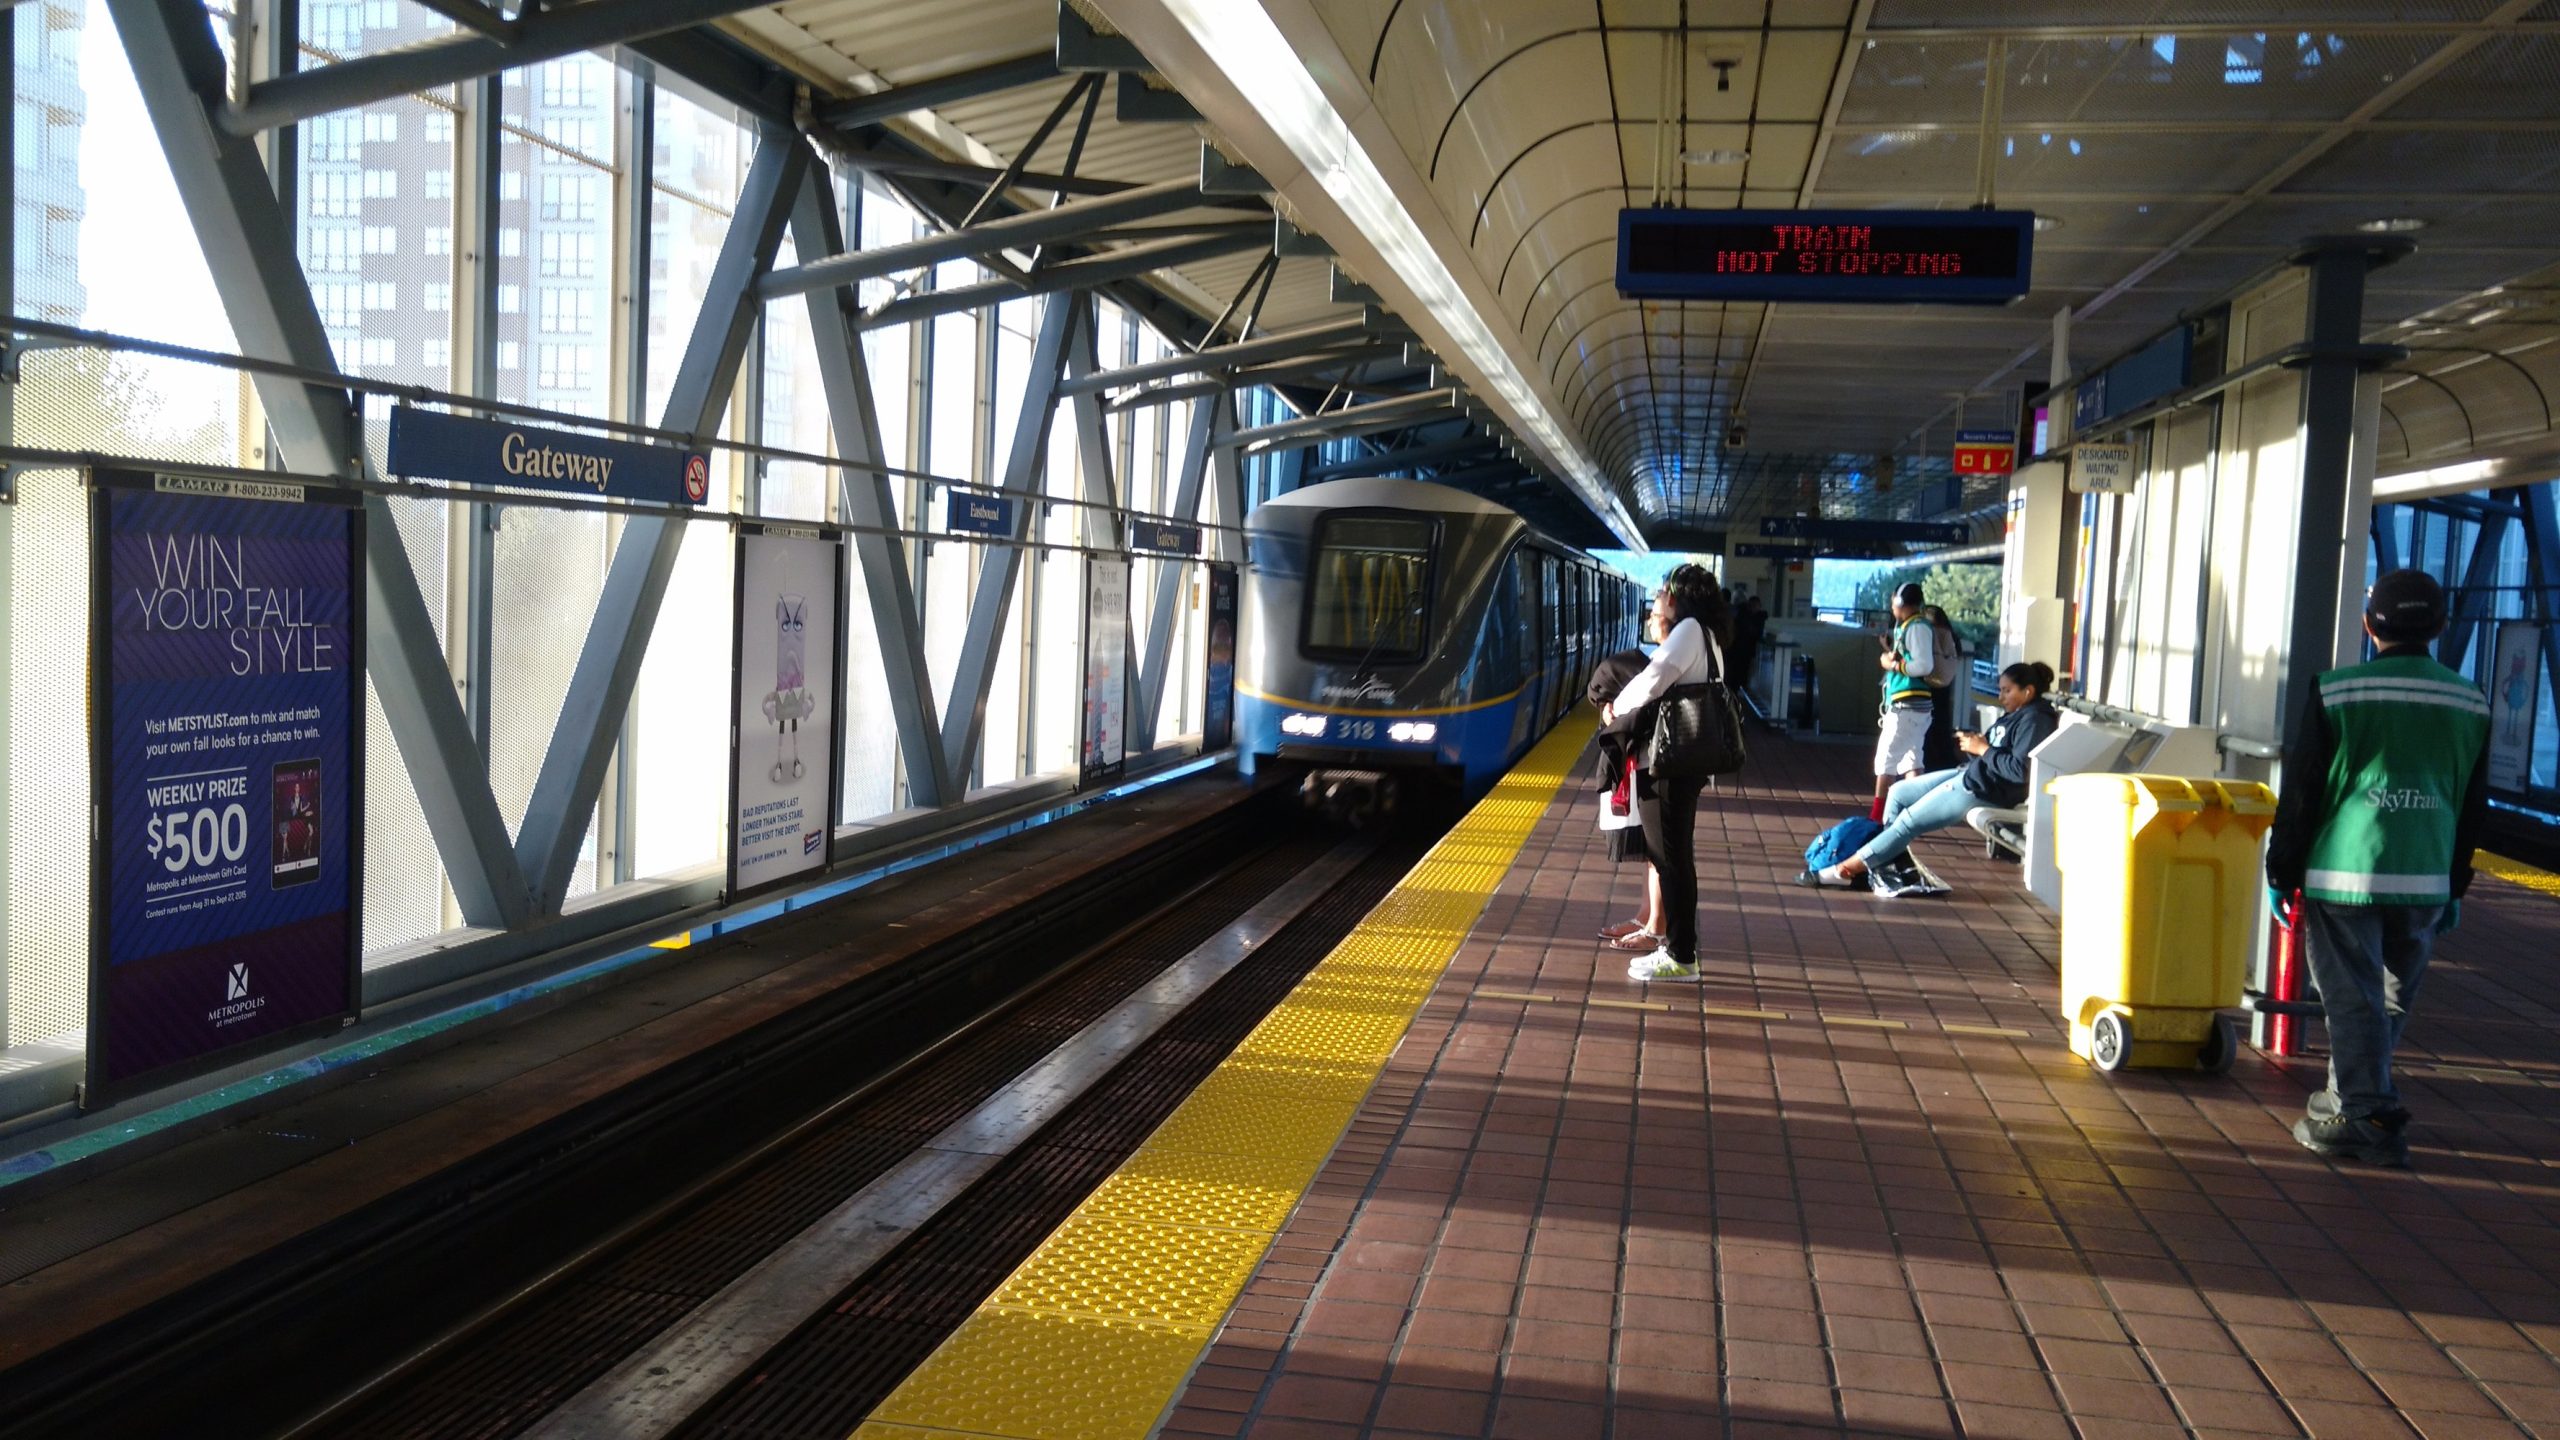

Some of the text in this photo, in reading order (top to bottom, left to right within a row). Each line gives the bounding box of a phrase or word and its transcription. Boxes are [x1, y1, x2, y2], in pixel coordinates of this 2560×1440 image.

[1773, 225, 1871, 251] TRAIN
[1717, 250, 1961, 276] NOT STOPPING
[501, 431, 613, 492] Gateway
[2077, 448, 2129, 460] DESIGNATED
[2086, 463, 2119, 476] WAITING
[165, 477, 302, 499] LAMAR 1-800-233-9942
[2089, 477, 2112, 489] AREA
[970, 502, 999, 521] Eastbound
[1156, 527, 1181, 551] Gateway
[147, 532, 243, 590] WIN
[135, 587, 313, 631] YOUR FALL
[230, 625, 332, 676] STYLE
[145, 705, 321, 735] Visit METSTYLIST.com to mix and match
[1336, 719, 1376, 741] 318
[146, 725, 320, 760] your own fall looks for a chance to win.
[147, 776, 247, 808] WEEKLY PRIZE
[742, 797, 799, 818] BAD REPUTATIONS LAST
[742, 819, 762, 833] LONGER
[763, 815, 777, 827] THAN
[777, 812, 788, 823] THIS
[147, 803, 248, 872] $500
[741, 834, 761, 847] BETTER
[761, 829, 774, 841] VISIT
[774, 826, 784, 837] THE
[146, 863, 247, 893] Metropolis at Metrotown Gift Card
[146, 908, 166, 919] Contest
[166, 906, 178, 915] runs
[179, 903, 192, 912] from
[192, 900, 203, 910] Aug
[216, 895, 227, 905] Sept
[208, 996, 265, 1022] METROPOLIS
[216, 1010, 257, 1028] at metrotown
